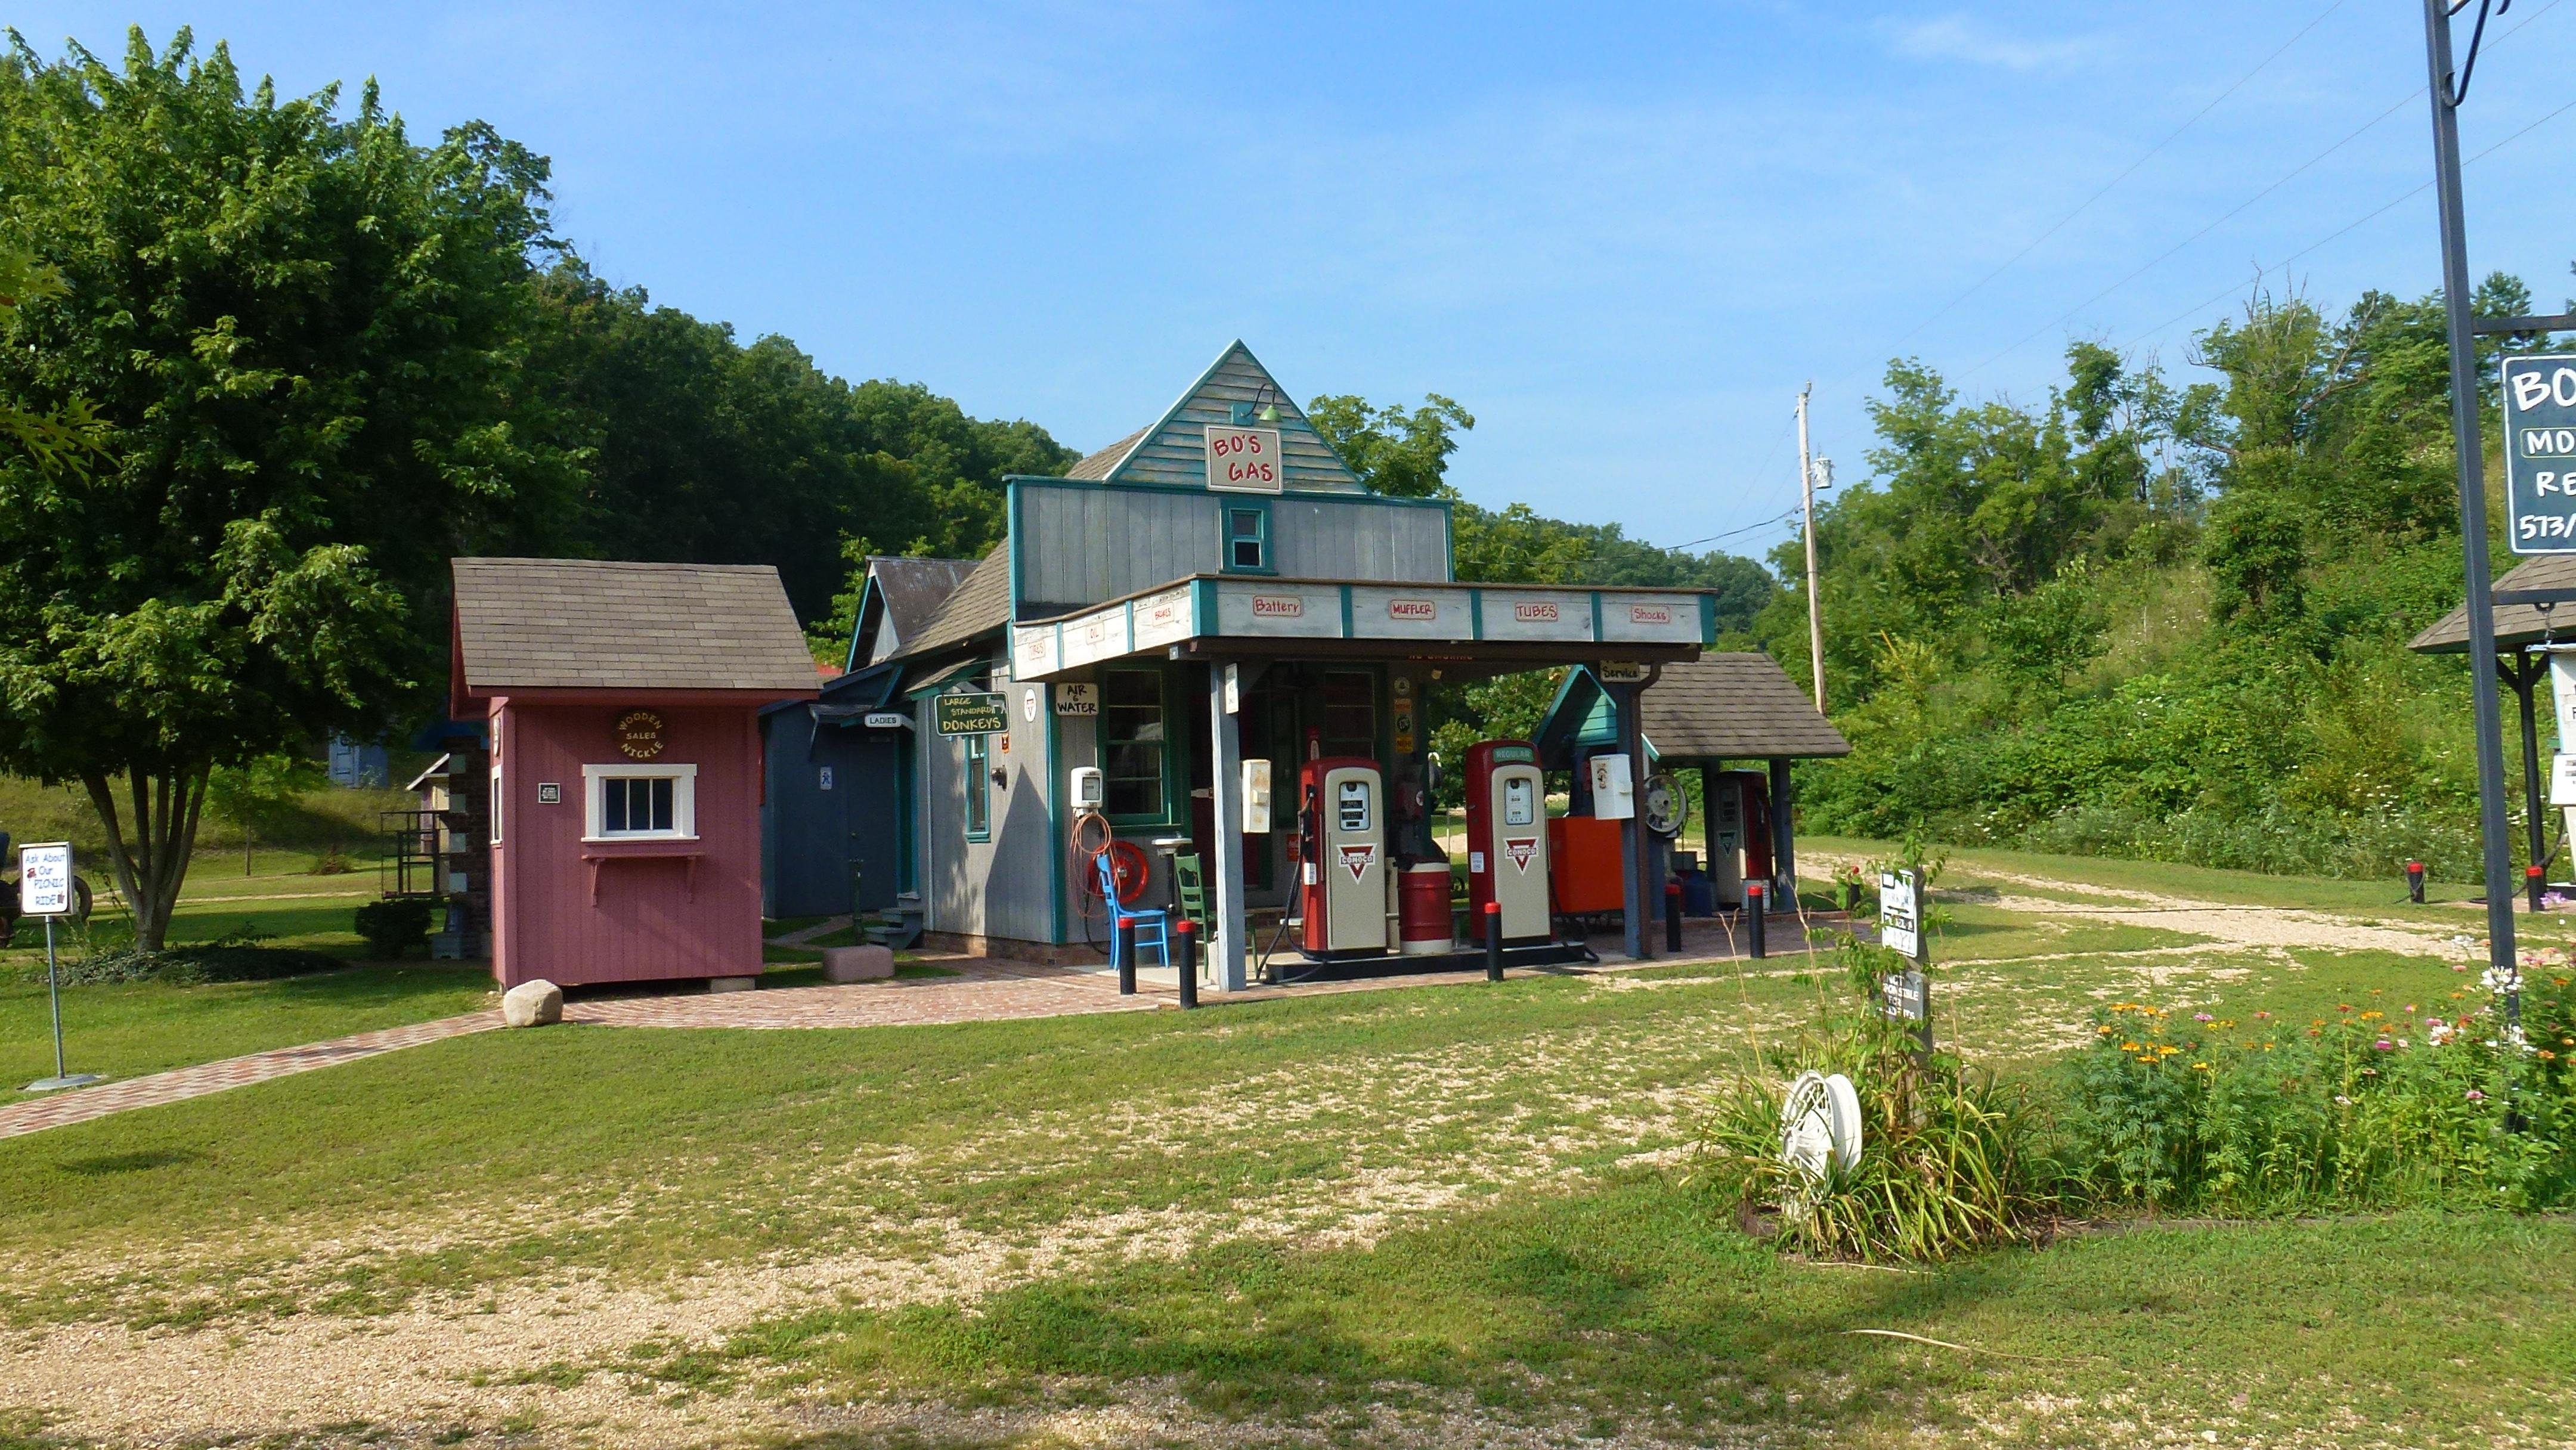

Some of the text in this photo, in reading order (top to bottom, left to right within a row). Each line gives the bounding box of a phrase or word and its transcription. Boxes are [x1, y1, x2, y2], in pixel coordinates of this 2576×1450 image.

[1213, 434, 1262, 458] BO'S
[1228, 462, 1274, 483] GAS
[1393, 604, 1432, 615] MUFFLER
[1515, 605, 1558, 618] TUBES
[1634, 608, 1666, 620] Shocks
[1090, 628, 1099, 639] OIL
[1067, 685, 1087, 696] AIR
[945, 698, 971, 706] LARGE
[950, 707, 993, 716] STANDARD
[1058, 702, 1096, 714] WATER
[619, 712, 662, 730] WOODEN
[943, 717, 1001, 731] DONKEYS
[621, 741, 663, 758] NICKLE
[26, 852, 65, 863] Ask About
[1342, 856, 1372, 864] CONOCO
[39, 866, 53, 875] Our
[36, 894, 56, 905] RIDE
